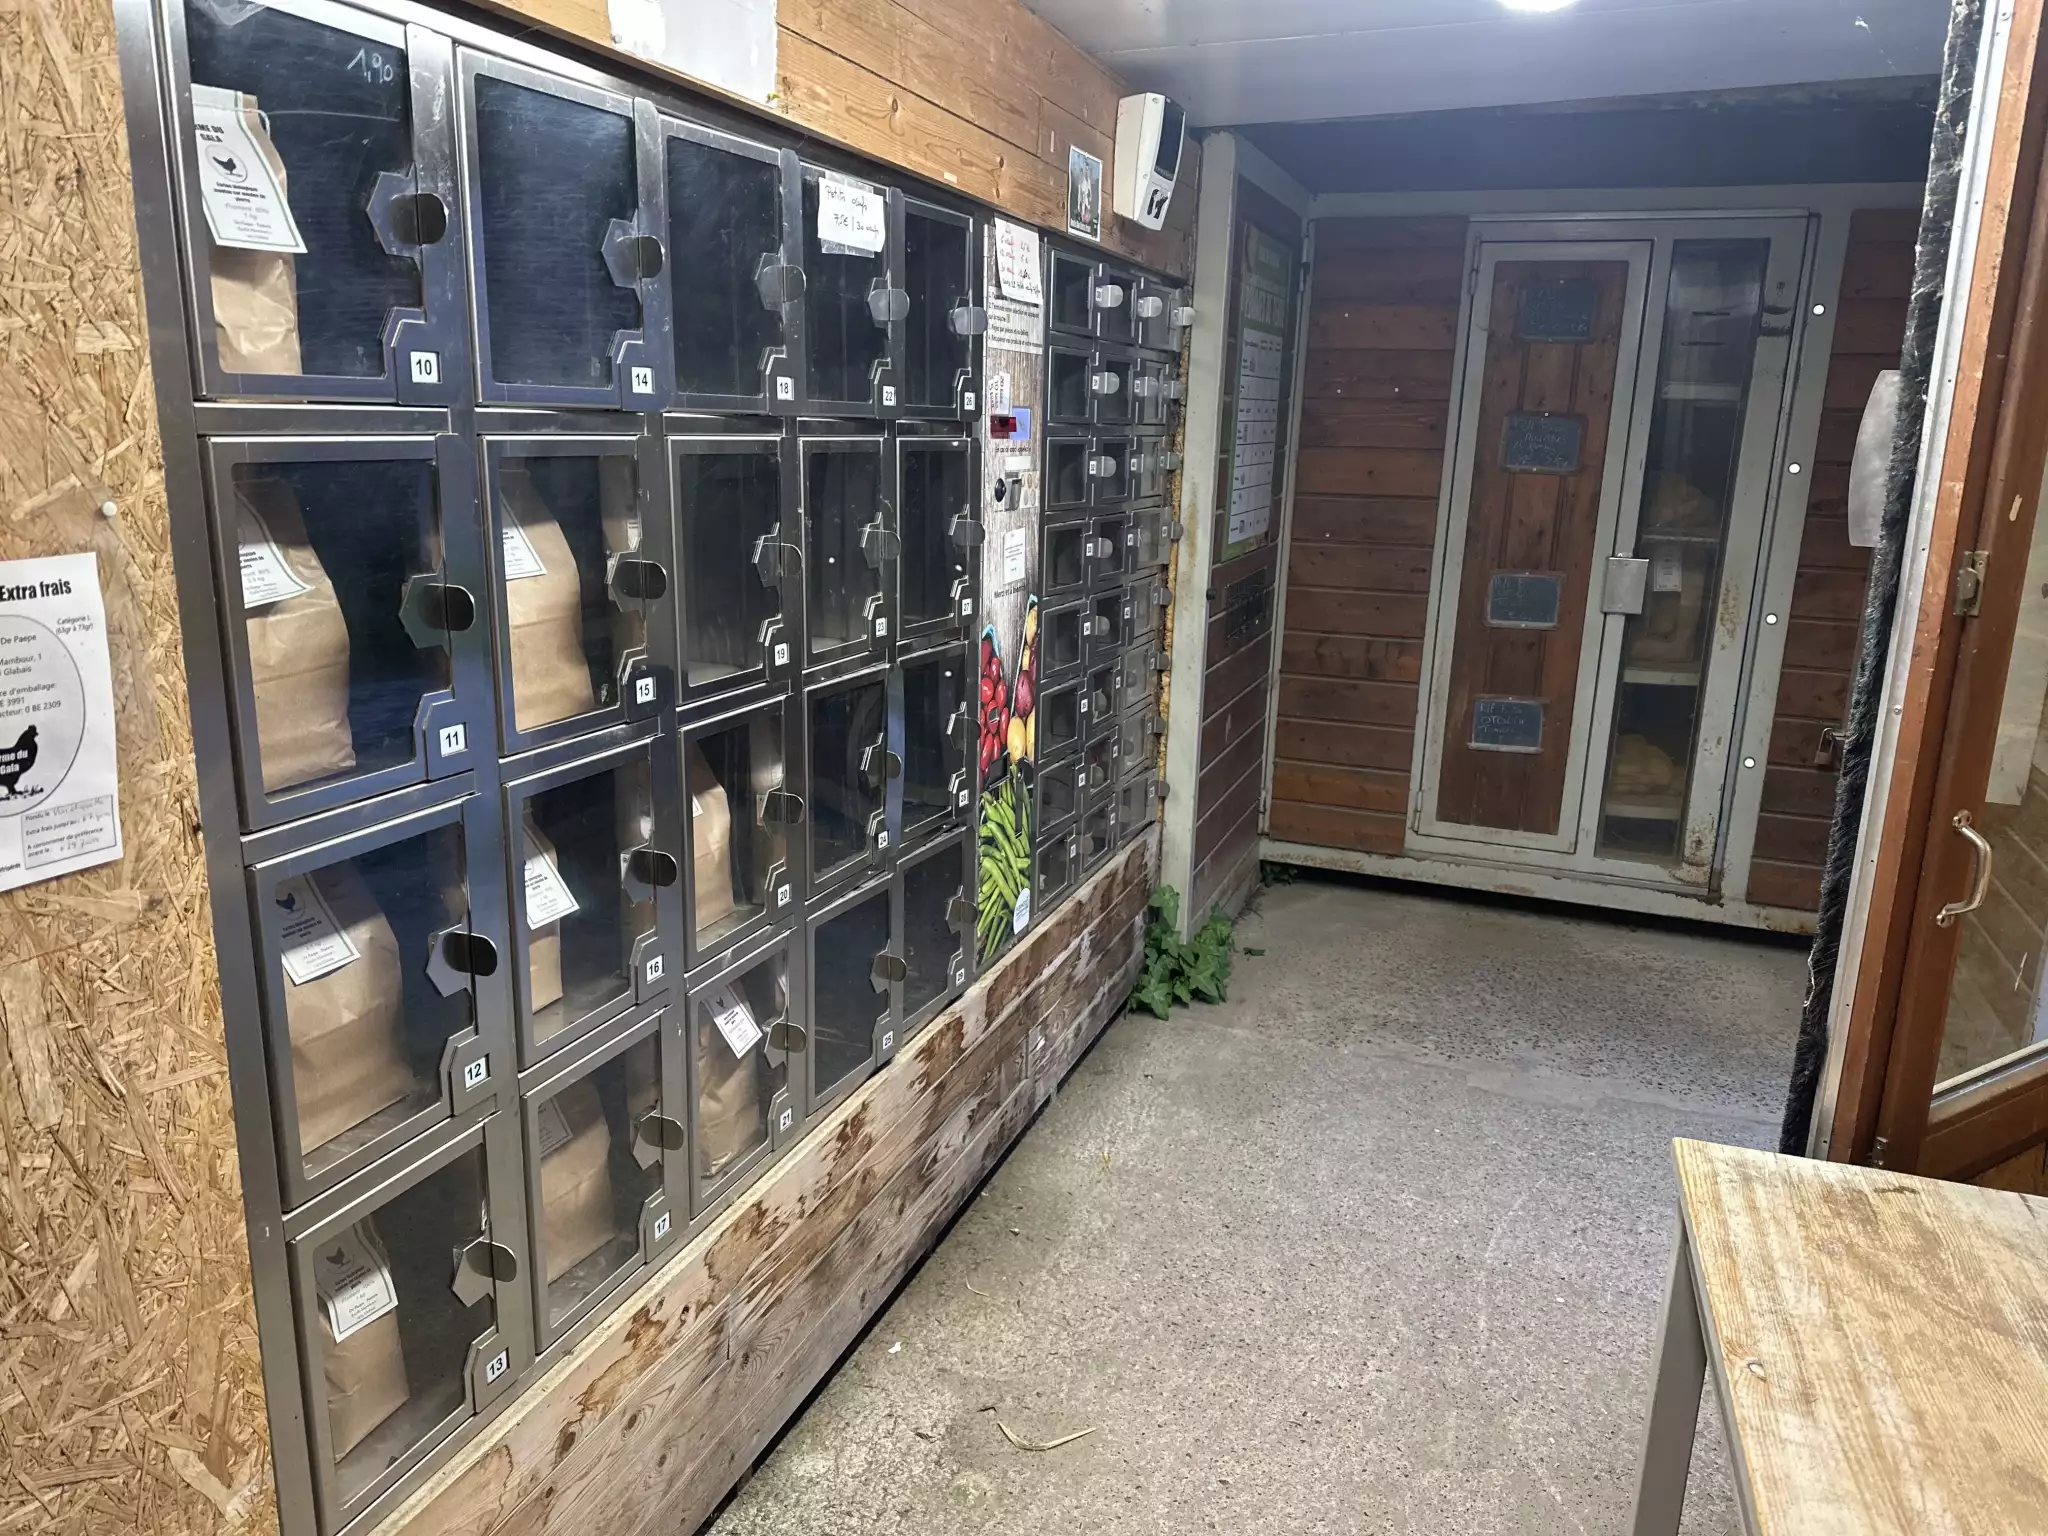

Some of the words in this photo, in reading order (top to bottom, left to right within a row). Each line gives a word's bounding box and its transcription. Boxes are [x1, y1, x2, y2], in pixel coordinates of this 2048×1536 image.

[415, 359, 433, 376] 10
[635, 372, 648, 387] 14
[779, 382, 789, 394] 18
[885, 391, 893, 402] 22
[0, 585, 37, 602] Extra
[39, 578, 72, 598] frais
[963, 602, 970, 612] 27
[57, 616, 86, 626] Catégorie
[877, 622, 885, 632] 23
[0, 637, 12, 645] De
[13, 634, 37, 644] Paepe
[776, 648, 785, 659] 19
[3, 665, 32, 676] Glabais
[638, 684, 650, 697] 15
[32, 704, 41, 712] BE
[43, 700, 61, 710] 2309
[445, 732, 459, 748] 11
[0, 752, 15, 763] rme
[17, 749, 28, 760] du
[0, 763, 20, 775] Gala
[880, 835, 887, 845] 24
[780, 889, 788, 901] 20
[649, 960, 659, 976] 16
[467, 1063, 482, 1081] 12
[782, 1113, 790, 1126] 21
[656, 1218, 667, 1234] 17
[489, 1357, 503, 1377] 13
